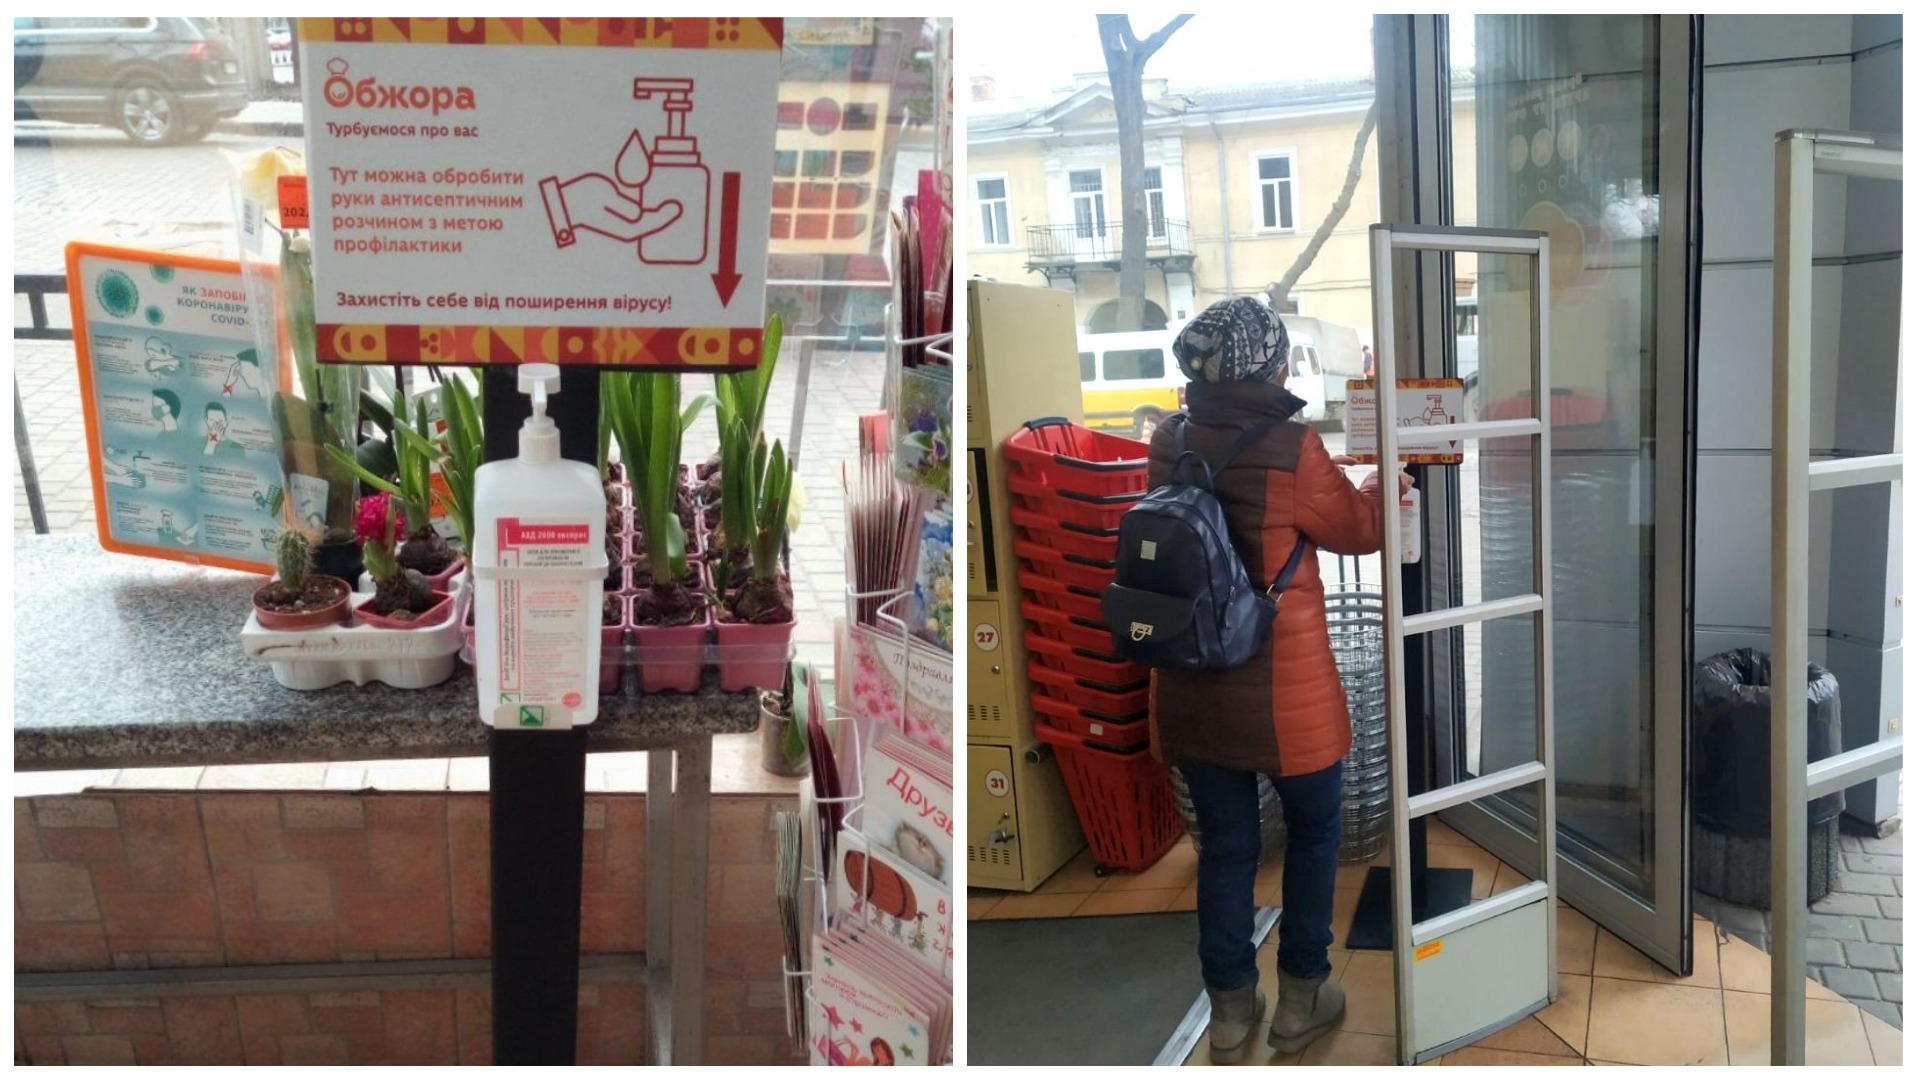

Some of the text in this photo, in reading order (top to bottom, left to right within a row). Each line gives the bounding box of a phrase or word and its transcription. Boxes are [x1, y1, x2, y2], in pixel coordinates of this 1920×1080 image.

[324, 75, 476, 115] Обжора
[326, 122, 479, 139] Турбуємося про вас
[329, 167, 524, 187] Тут можна обробити
[331, 192, 524, 209] руки антисептичним
[332, 216, 504, 232] розчином з метою
[333, 236, 462, 254] профілактики
[182, 286, 197, 296] ЯК
[336, 291, 672, 314] Захистіть себе від поширення вірусу!
[976, 631, 994, 643] 27
[990, 778, 1005, 790] 31
